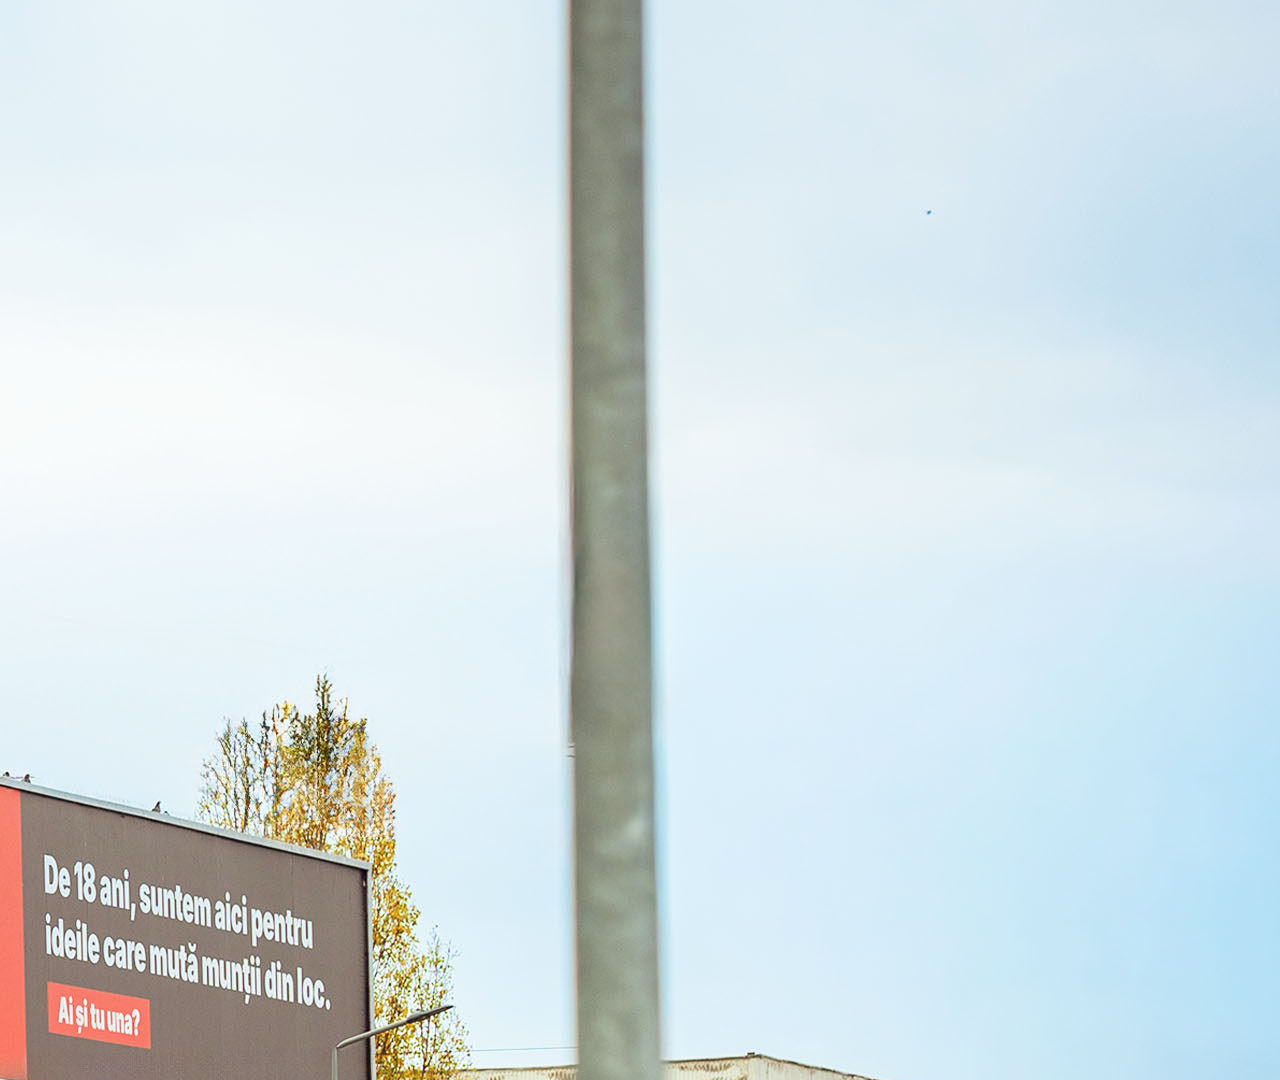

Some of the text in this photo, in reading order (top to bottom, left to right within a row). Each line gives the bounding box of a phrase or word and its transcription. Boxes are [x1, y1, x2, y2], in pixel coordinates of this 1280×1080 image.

[44, 854, 313, 949] De 18 ani, suntem aici pentru
[45, 913, 331, 1010] ideile care mută munții din loc.
[58, 996, 141, 1036] Ai și tu una?
